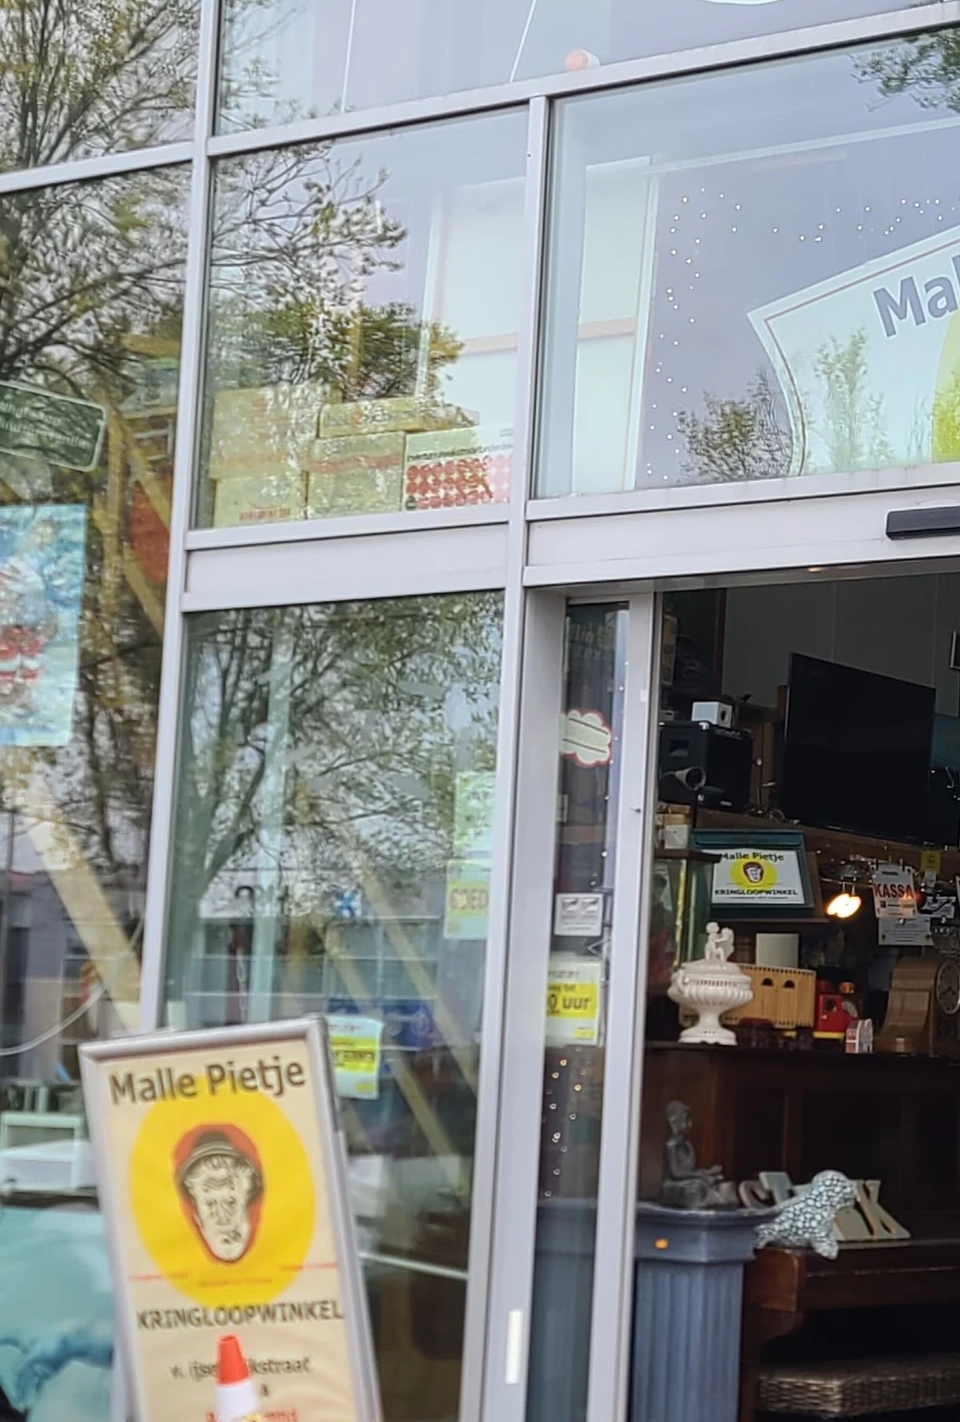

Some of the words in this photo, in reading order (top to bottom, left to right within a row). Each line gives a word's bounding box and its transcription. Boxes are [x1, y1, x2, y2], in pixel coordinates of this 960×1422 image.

[873, 883, 914, 899] KASSA
[562, 997, 591, 1011] uur
[108, 1067, 198, 1106] Malle
[204, 1055, 307, 1097] Pietje
[136, 1299, 345, 1331] KRINGLOOPWINKEL
